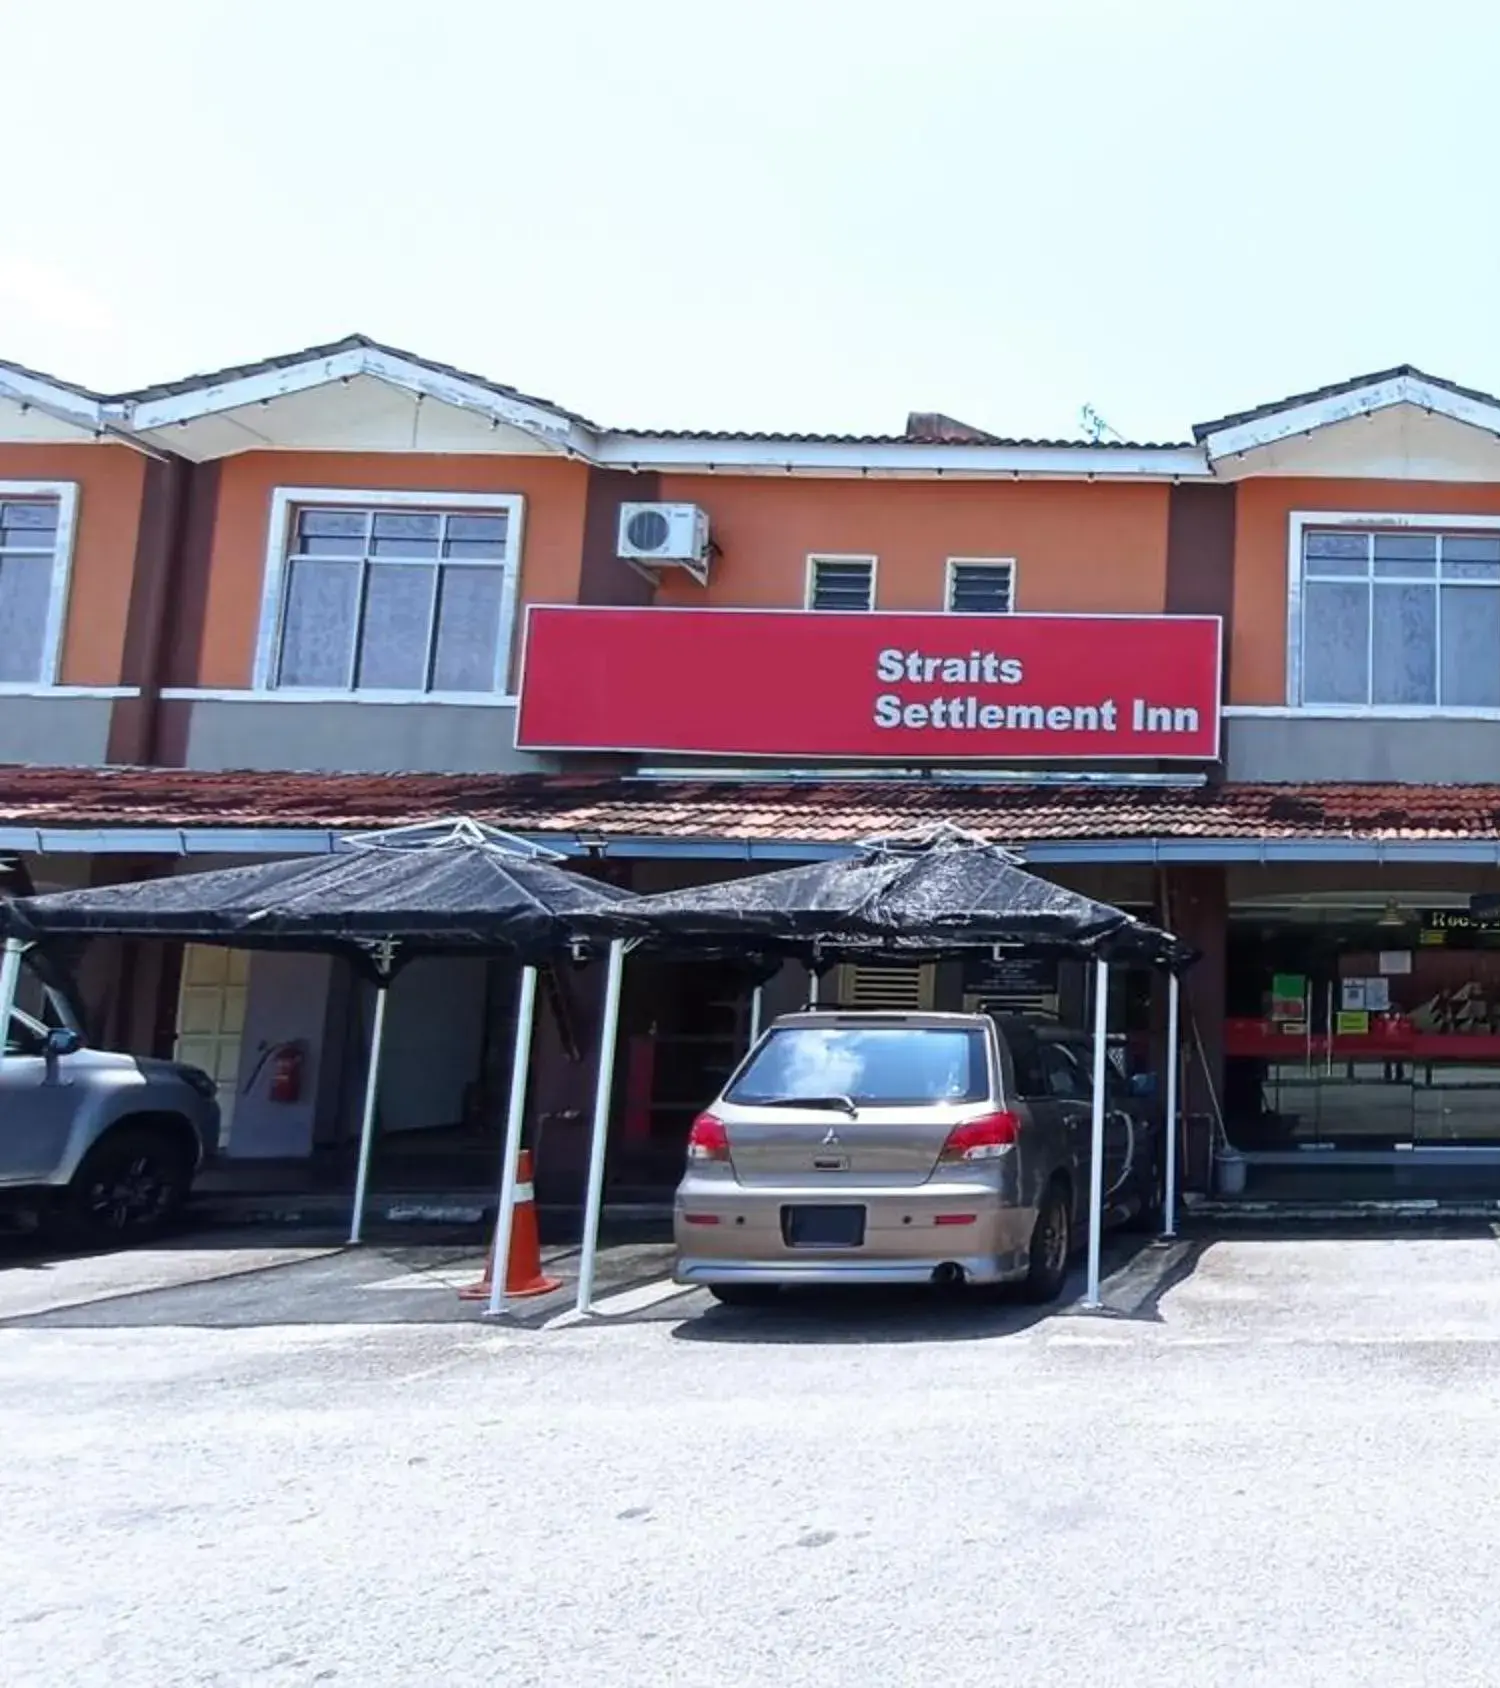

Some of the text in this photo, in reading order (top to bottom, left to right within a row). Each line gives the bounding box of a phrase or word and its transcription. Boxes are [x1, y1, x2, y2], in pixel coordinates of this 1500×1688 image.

[875, 648, 1023, 684] Straits
[874, 694, 1200, 732] Settlement Inn
